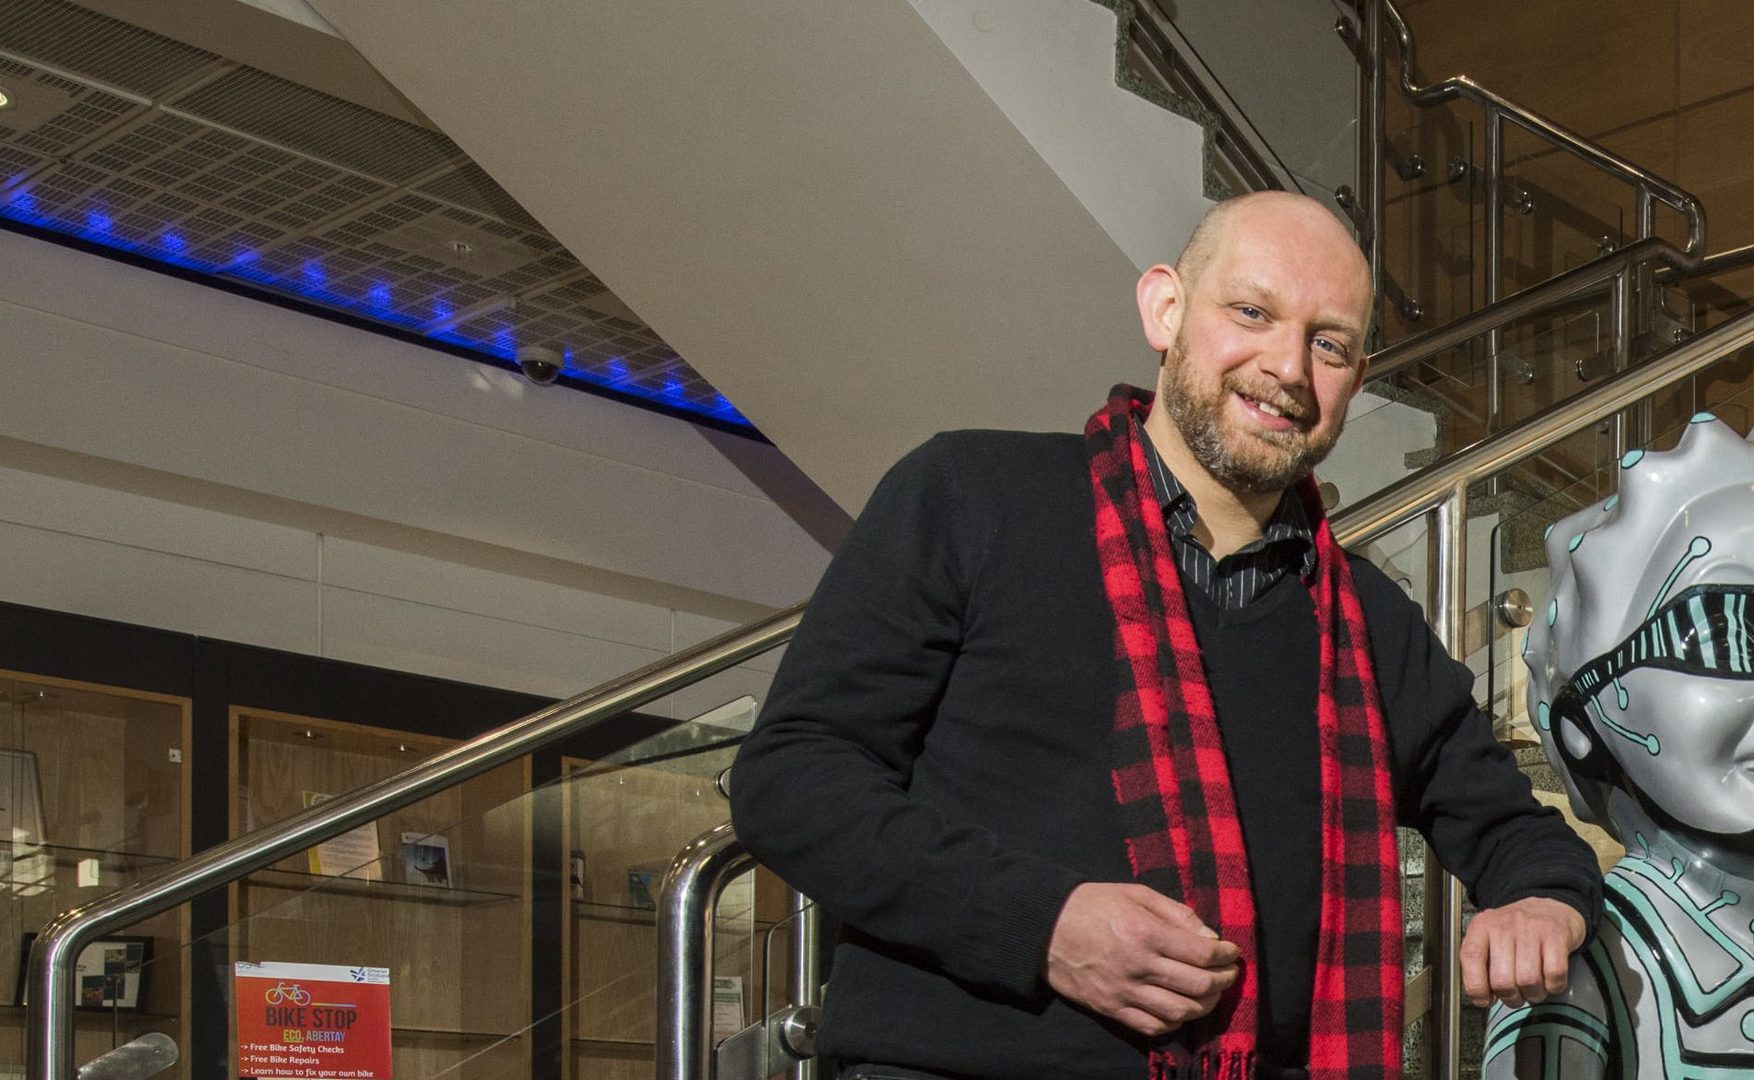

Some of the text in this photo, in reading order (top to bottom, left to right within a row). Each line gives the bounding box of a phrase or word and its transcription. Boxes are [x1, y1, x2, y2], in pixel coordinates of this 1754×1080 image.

[266, 1006, 357, 1030] BIKE STOP
[306, 1030, 346, 1043] ABERTAY
[250, 1043, 345, 1055] Free Bike Safety Checks
[250, 1055, 320, 1066] Free Bike Repairs
[250, 1067, 374, 1078] Learn how to fix your own bike
